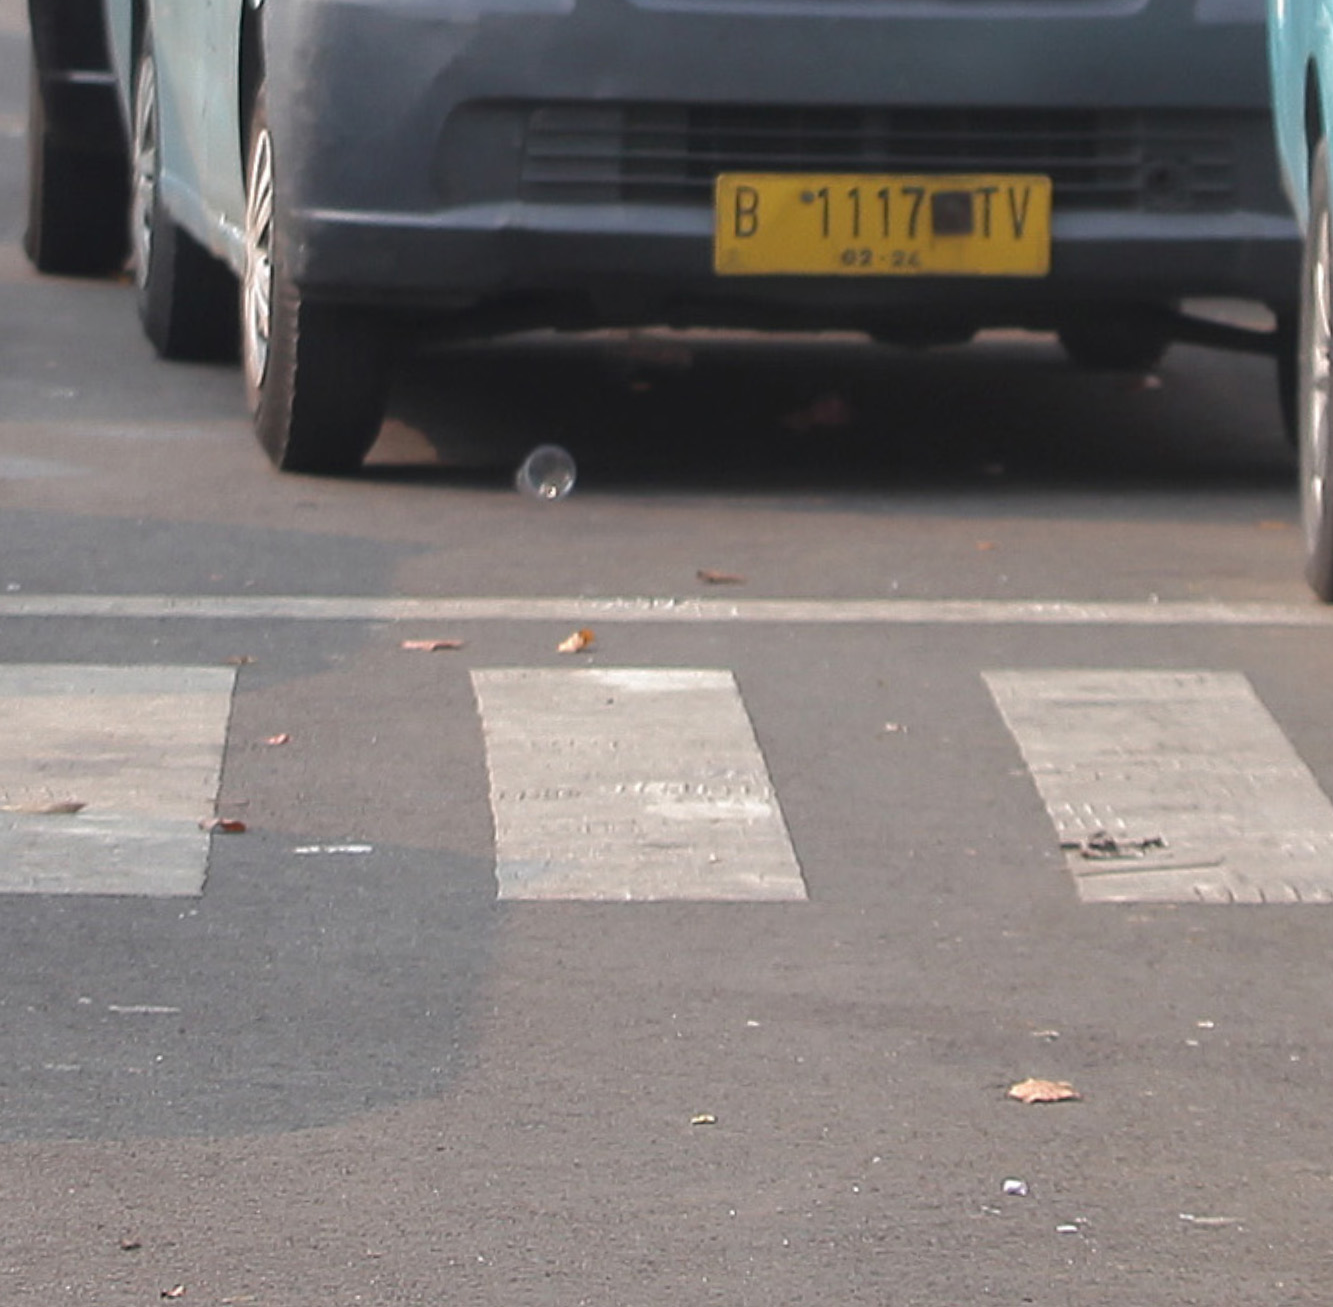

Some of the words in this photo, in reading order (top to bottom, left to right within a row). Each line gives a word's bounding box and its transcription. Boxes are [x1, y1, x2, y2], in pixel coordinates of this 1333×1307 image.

[734, 186, 759, 239] B
[818, 186, 926, 240] 1117
[976, 186, 1030, 240] TV
